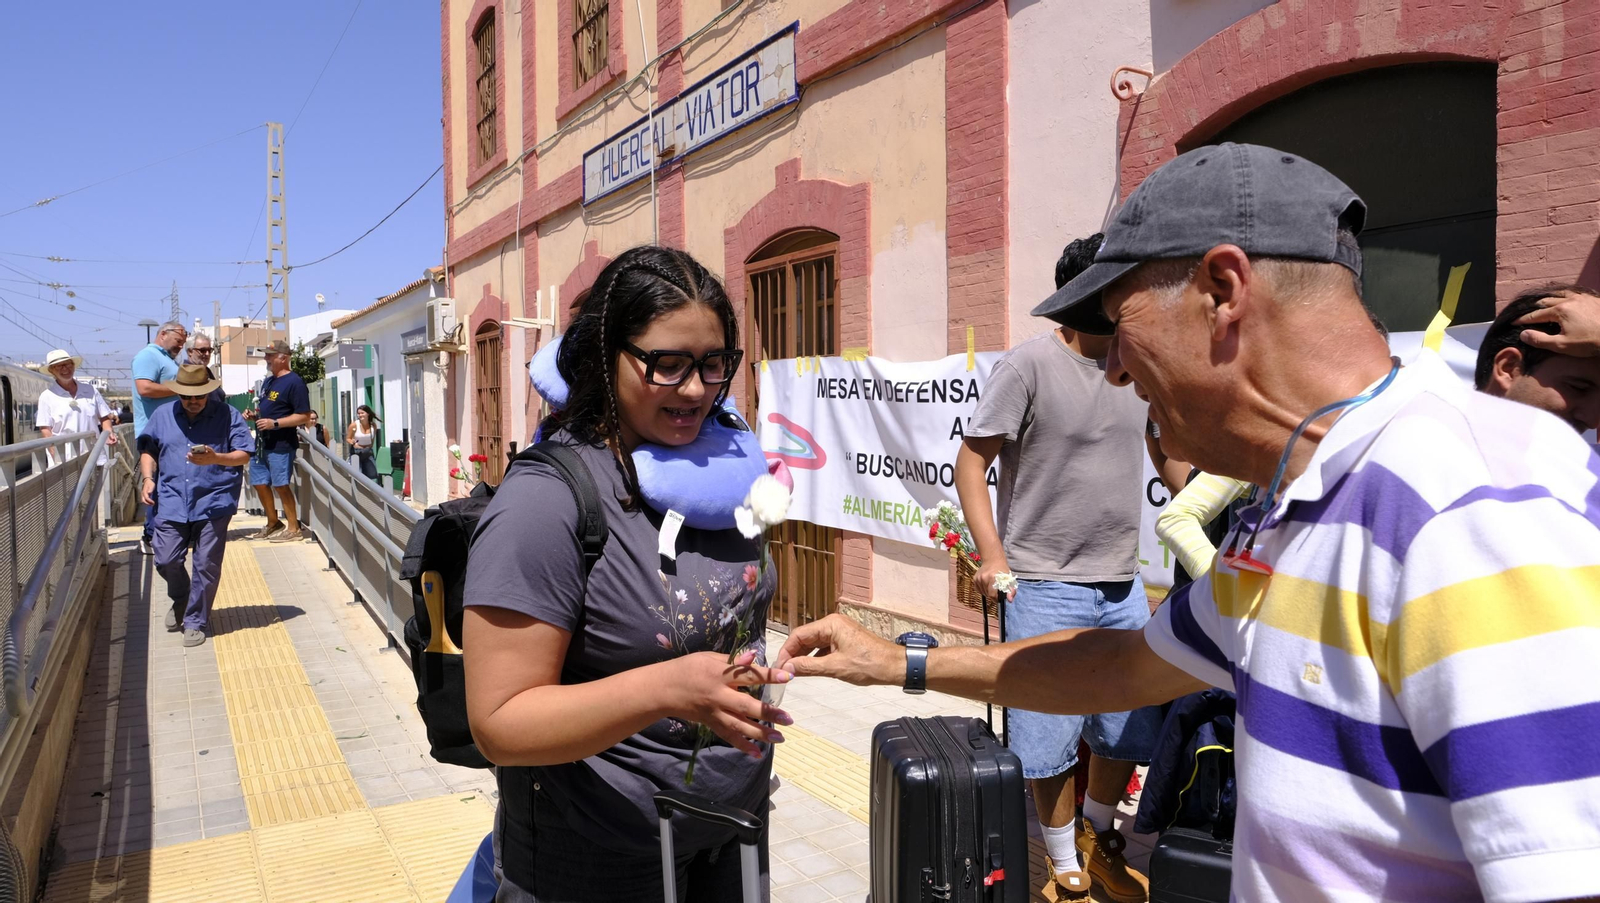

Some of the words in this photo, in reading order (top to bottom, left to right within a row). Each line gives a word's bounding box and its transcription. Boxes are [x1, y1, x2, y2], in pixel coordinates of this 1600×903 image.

[340, 356, 348, 368] 1
[817, 378, 860, 399] MESA
[863, 379, 882, 400] EN
[884, 379, 980, 403] DEFENSA
[856, 453, 954, 487] BUSCANDO
[843, 494, 923, 528] #ALMERÍA
